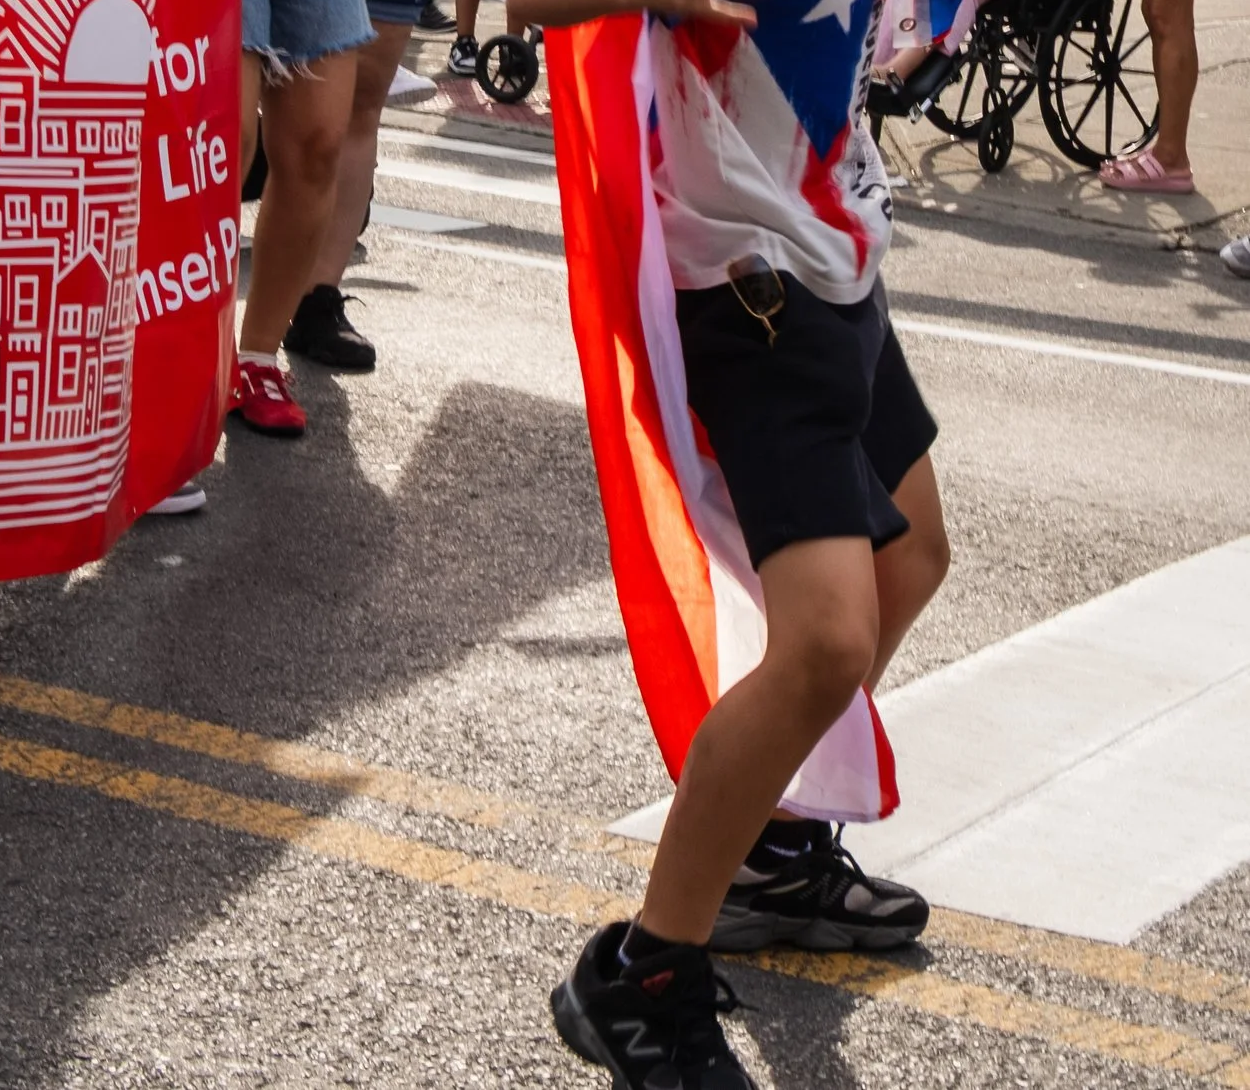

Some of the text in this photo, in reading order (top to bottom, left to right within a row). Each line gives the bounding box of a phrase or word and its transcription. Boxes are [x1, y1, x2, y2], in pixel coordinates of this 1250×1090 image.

[150, 26, 210, 97] for
[158, 120, 228, 203] Life
[135, 230, 220, 326] nset
